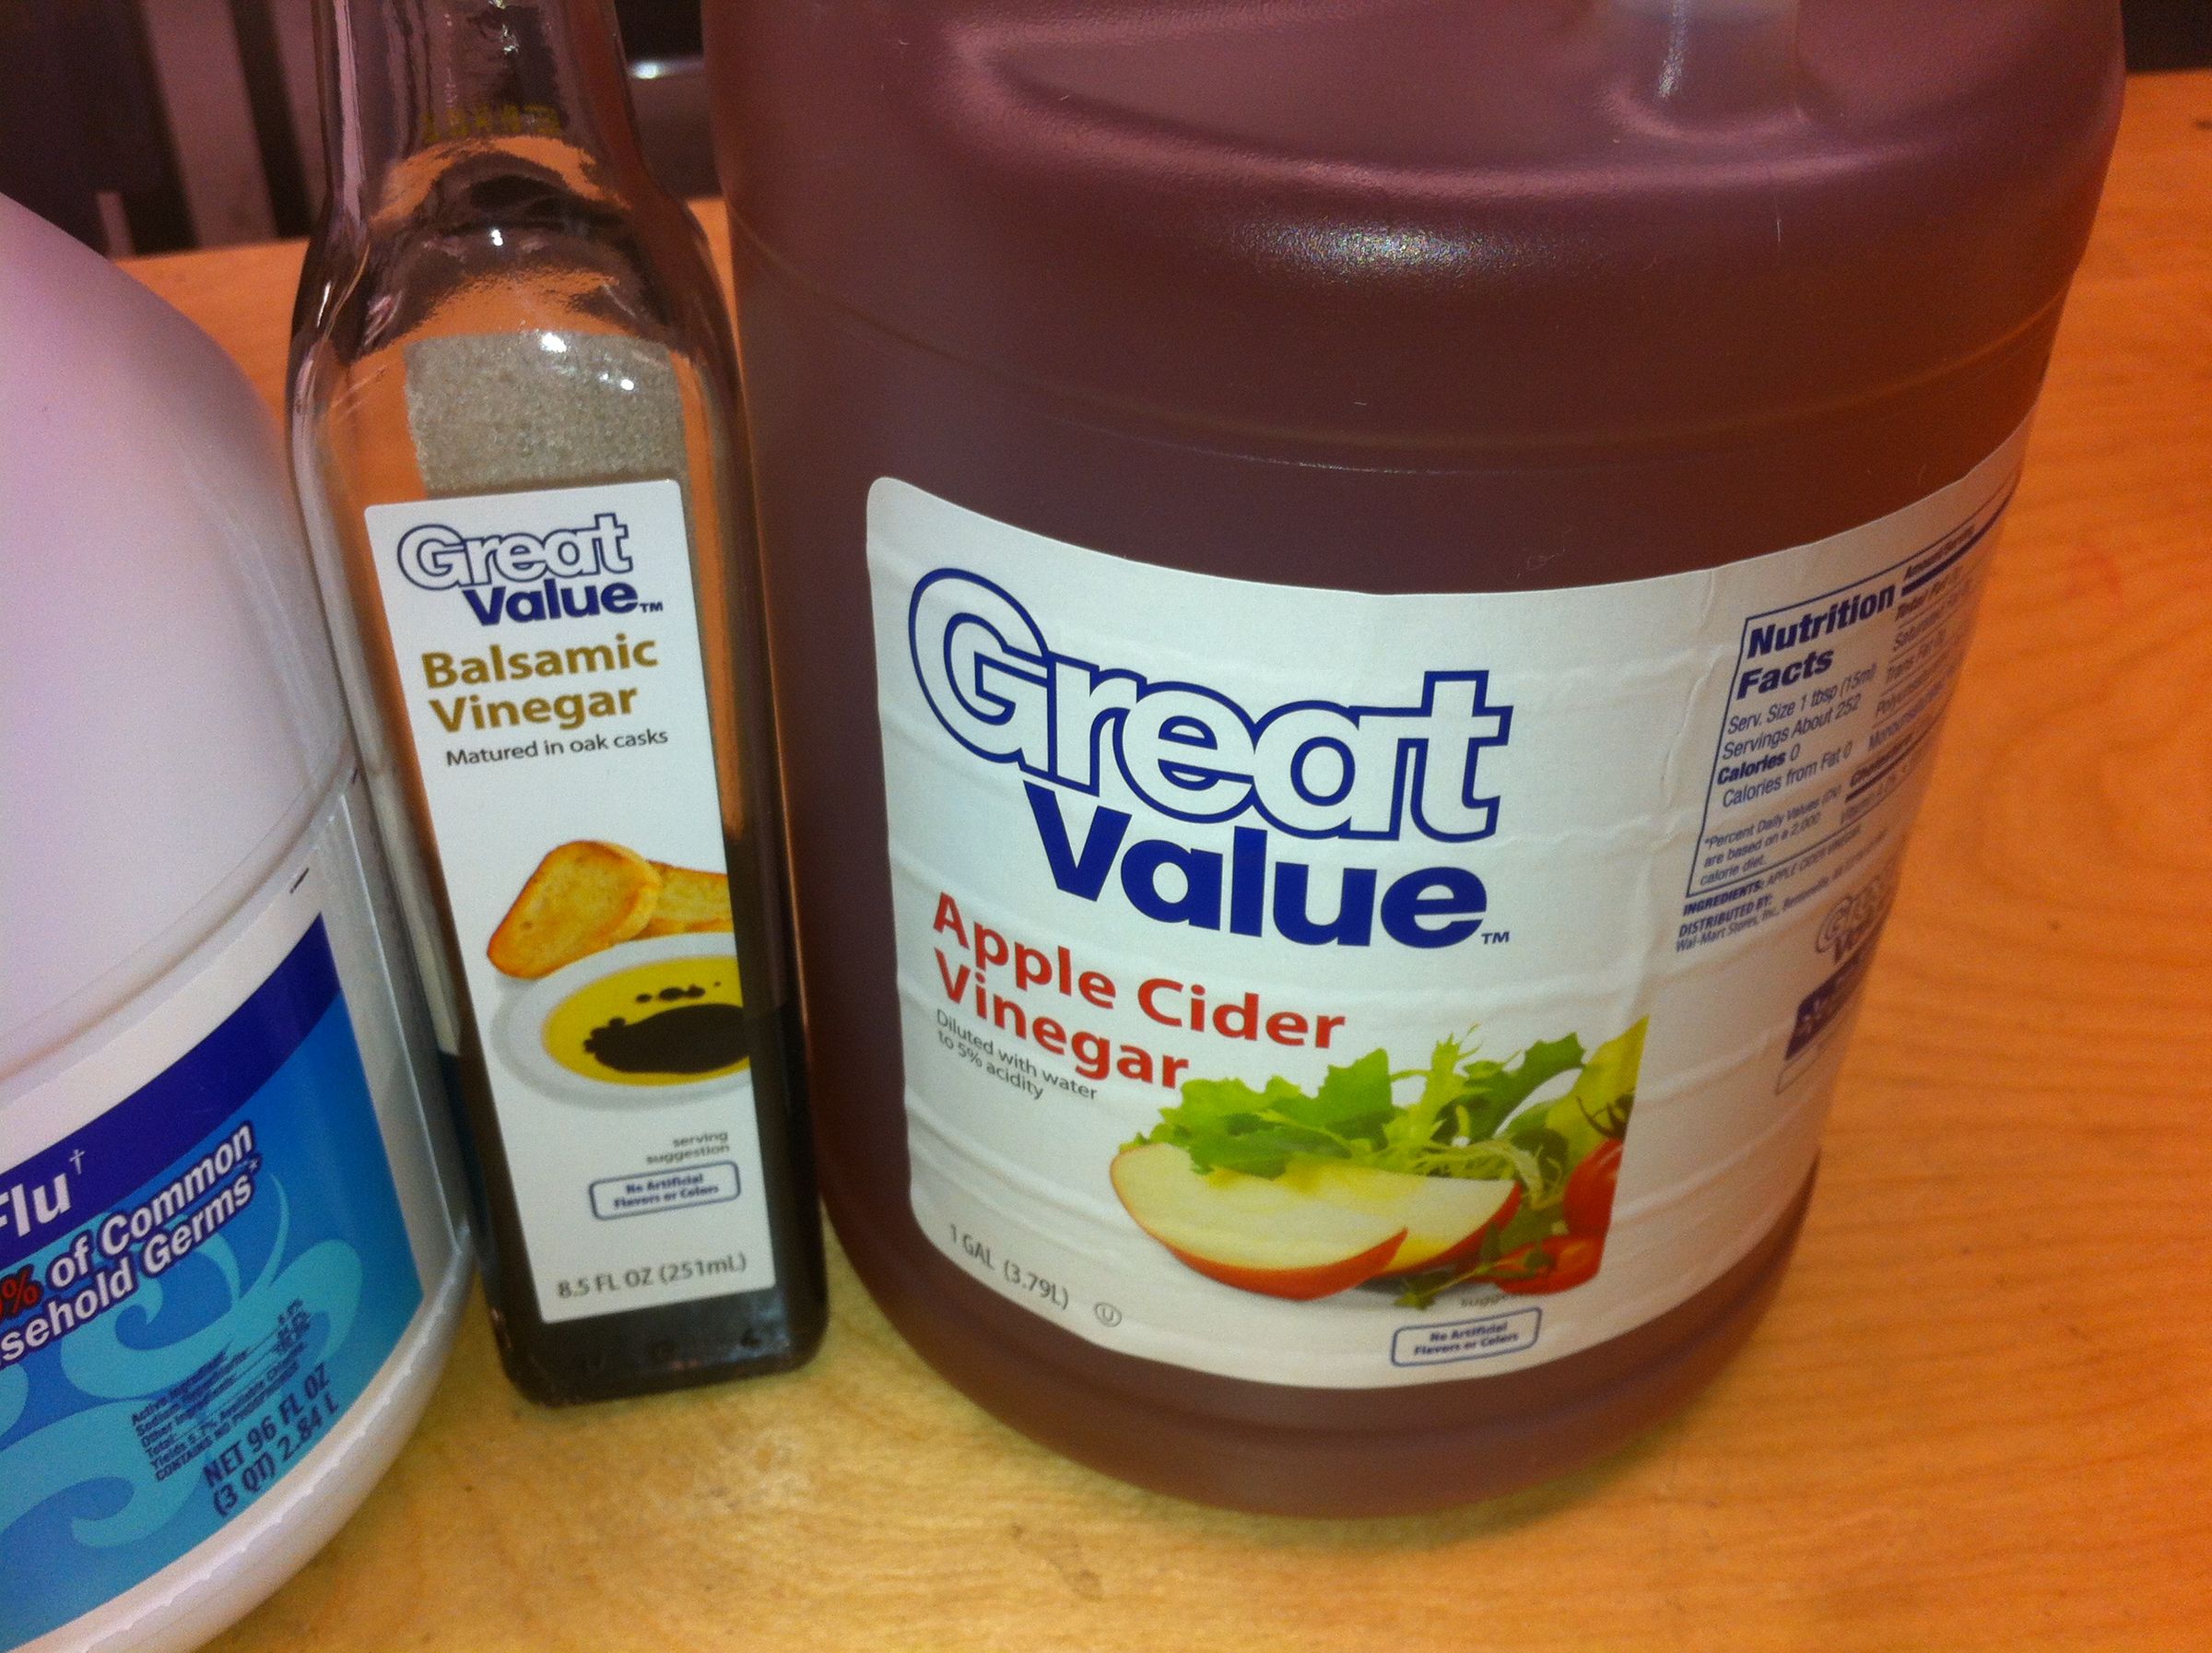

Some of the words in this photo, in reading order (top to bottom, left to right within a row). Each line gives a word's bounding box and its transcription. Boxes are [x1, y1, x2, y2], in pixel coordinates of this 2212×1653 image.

[397, 513, 634, 591] Great
[462, 579, 639, 627] Value
[1746, 584, 1897, 660] Nutrition
[421, 633, 660, 690] Balsamic
[1735, 648, 1835, 702] Facts
[429, 687, 639, 734] Vinegar
[908, 567, 1515, 844] Great
[1722, 726, 1790, 762] Servings
[1790, 707, 1834, 739] About
[1833, 692, 1862, 721] 252
[1727, 712, 1763, 736] Serv.
[1766, 699, 1796, 725] Size
[1800, 693, 1808, 712] 1
[1810, 685, 1839, 709] tbsp
[446, 741, 539, 768] Matured
[544, 739, 565, 756] in
[570, 735, 609, 754] oak
[613, 728, 669, 750] casks
[1717, 751, 1787, 785] Calories
[1790, 742, 1802, 762] 0
[1722, 775, 1783, 809] Calories
[1785, 762, 1819, 786] from
[1819, 746, 1841, 772] Fat
[1022, 778, 1488, 950] Value
[1699, 864, 1741, 887] calorie
[1703, 853, 1724, 868] are
[1725, 838, 1764, 862] based
[1678, 900, 1755, 939] DISTRIBUTED
[1683, 879, 1765, 917] INGREDIENTS:
[933, 891, 1118, 1010] Apple
[1136, 976, 1347, 1049] Cider
[934, 946, 1191, 1091] Vinegar
[935, 1008, 994, 1058] Diluted
[998, 1050, 1039, 1079] with
[1041, 1069, 1099, 1101] water
[937, 1030, 955, 1050] to
[957, 1041, 983, 1070] 5%
[985, 1061, 1044, 1101] acidity
[645, 1143, 731, 1165] suggestion
[671, 1130, 729, 1149] serving
[50, 1234, 90, 1289] of
[100, 1124, 253, 1257] Common
[646, 1173, 704, 1192] Artificial
[556, 1277, 591, 1300] 8.5
[595, 1274, 621, 1292] FL
[624, 1267, 653, 1289] OZ
[658, 1250, 747, 1286] (251mL)
[950, 1223, 958, 1244] 1
[961, 1234, 995, 1270] GAL
[1004, 1259, 1070, 1311] (3.79L)
[202, 1440, 245, 1489] NET
[246, 1414, 278, 1454] 96
[278, 1393, 305, 1426] FL
[303, 1361, 332, 1401] OZ
[213, 1483, 239, 1518] (3
[241, 1451, 277, 1494] QT)
[324, 1390, 340, 1417] L
